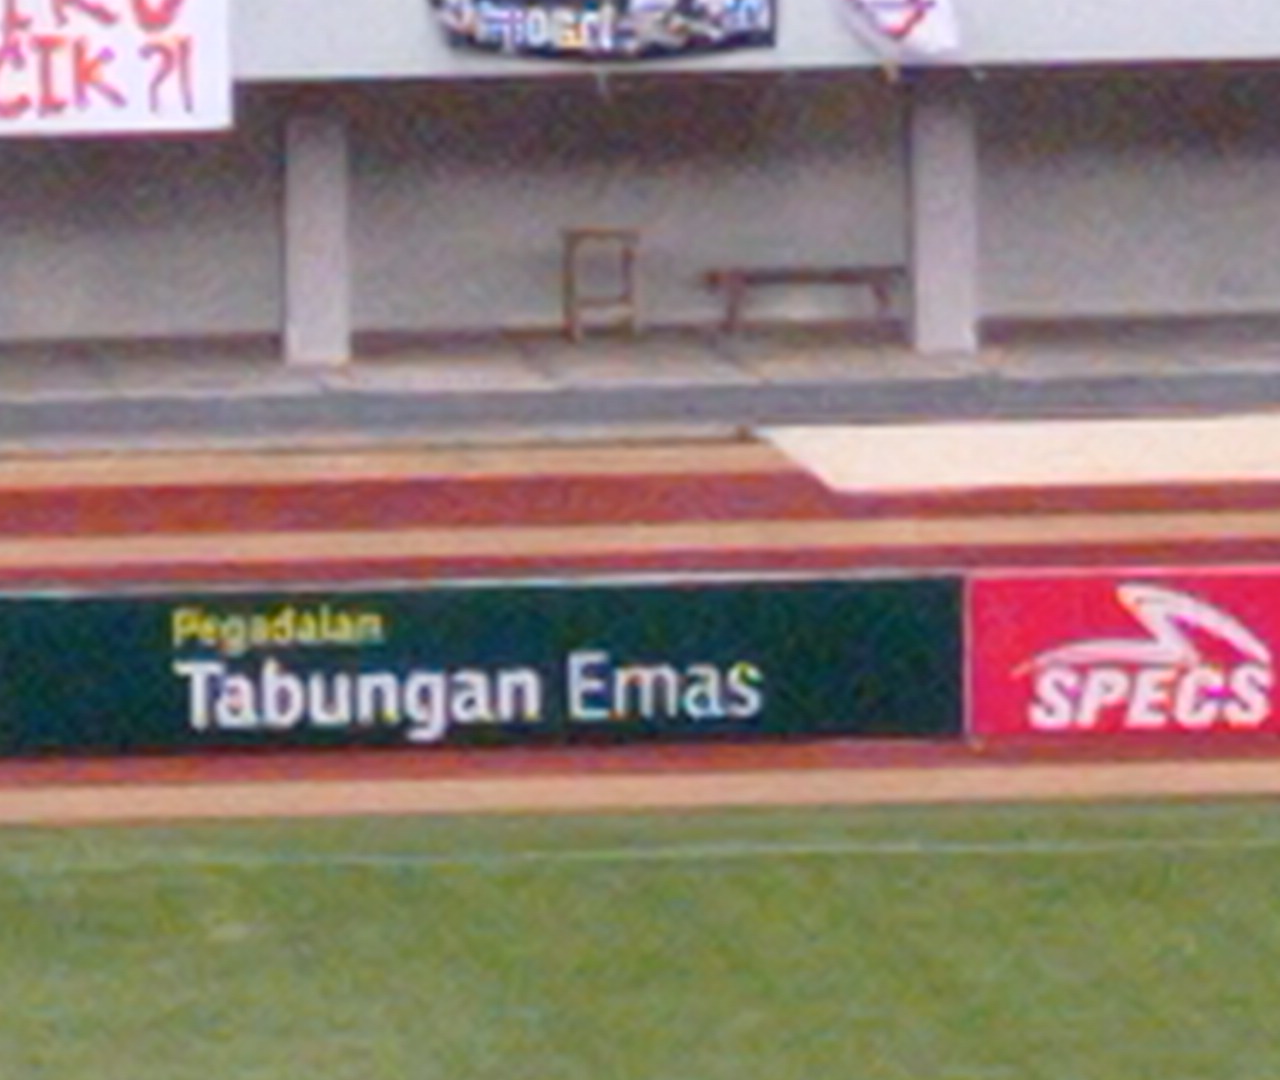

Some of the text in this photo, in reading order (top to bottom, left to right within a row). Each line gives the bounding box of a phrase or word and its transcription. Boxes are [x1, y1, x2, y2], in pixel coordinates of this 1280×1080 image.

[171, 650, 763, 744] Tabungan Emas
[1029, 664, 1272, 730] SPECS
